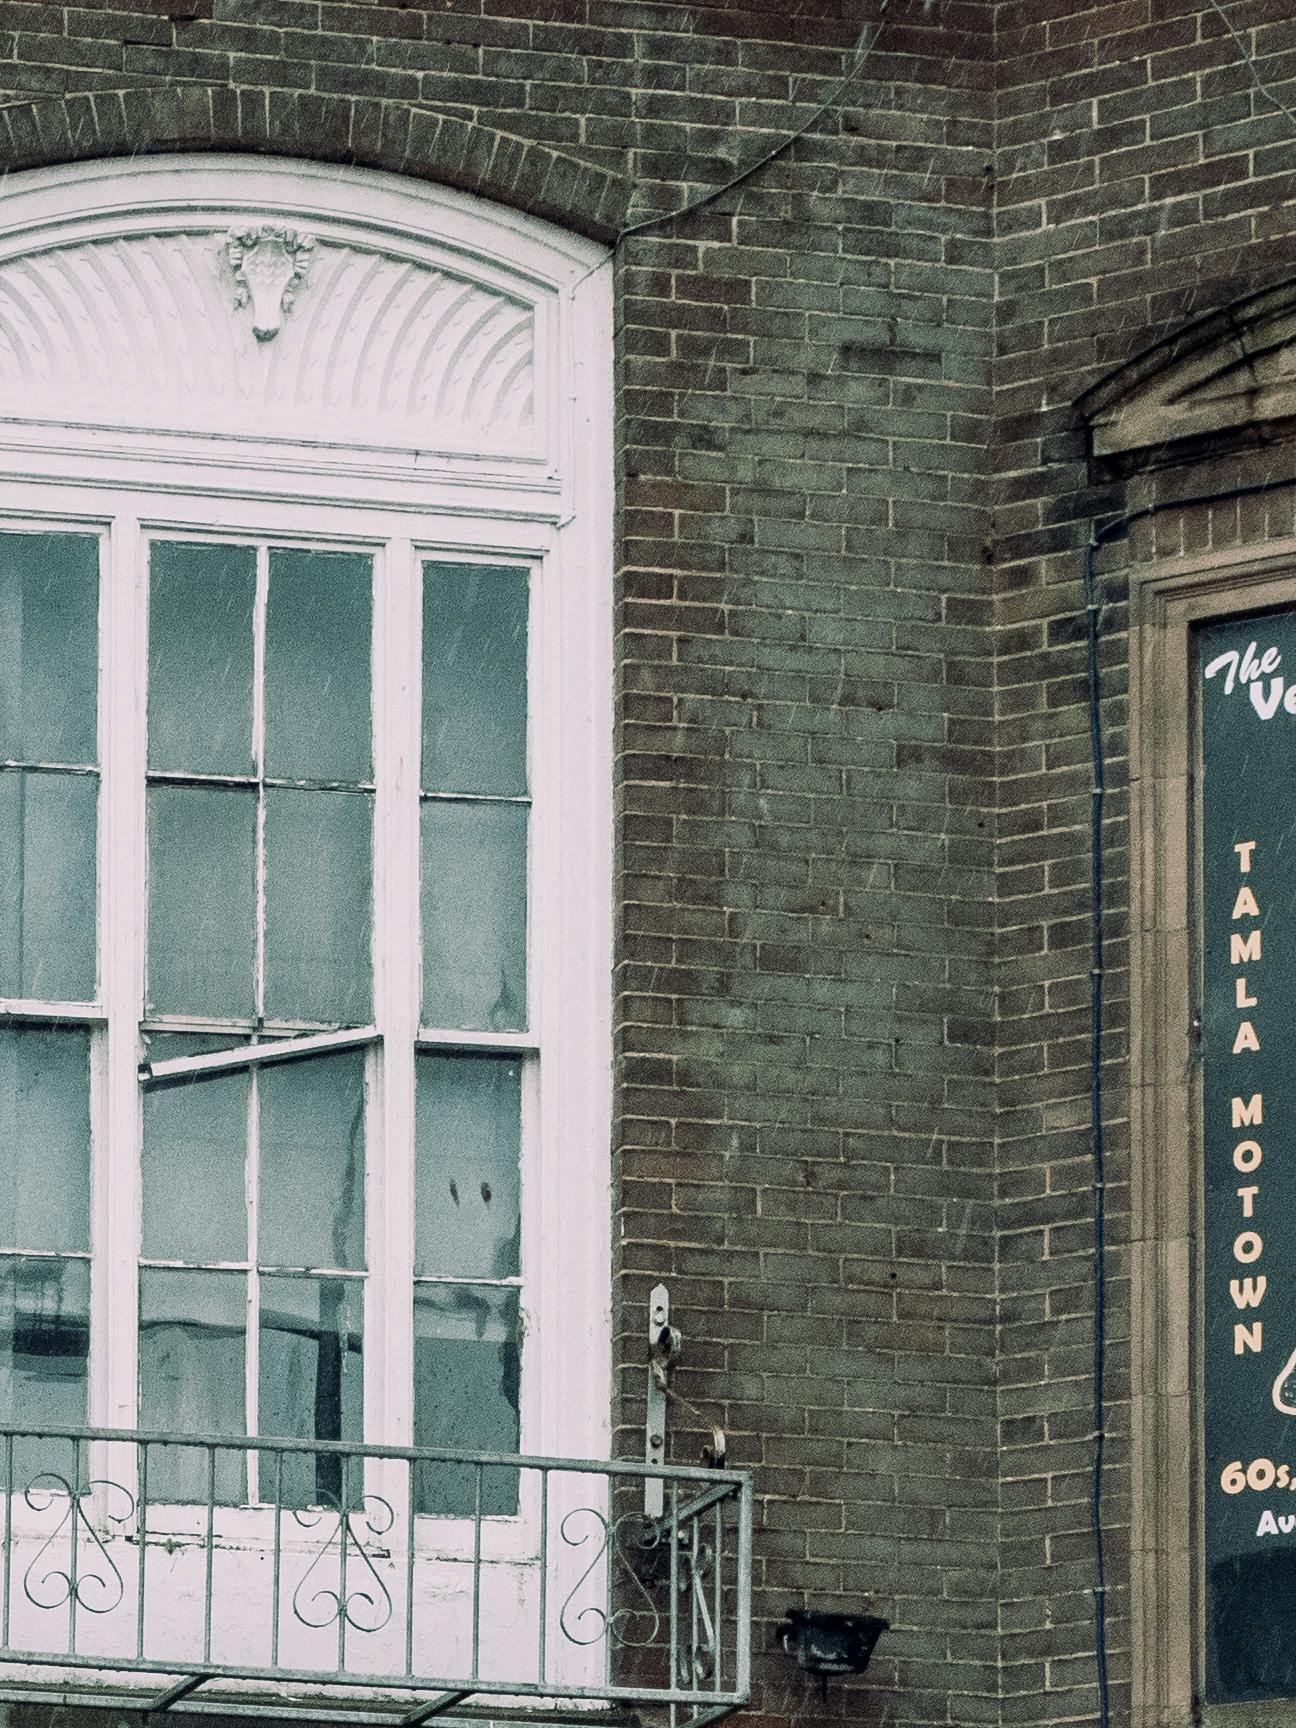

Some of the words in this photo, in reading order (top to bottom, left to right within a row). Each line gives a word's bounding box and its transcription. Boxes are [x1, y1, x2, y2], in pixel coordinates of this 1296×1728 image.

[1205, 641, 1281, 695] The
[1230, 841, 1262, 1054] TAMLA
[1230, 1094, 1266, 1355] MOTOWN
